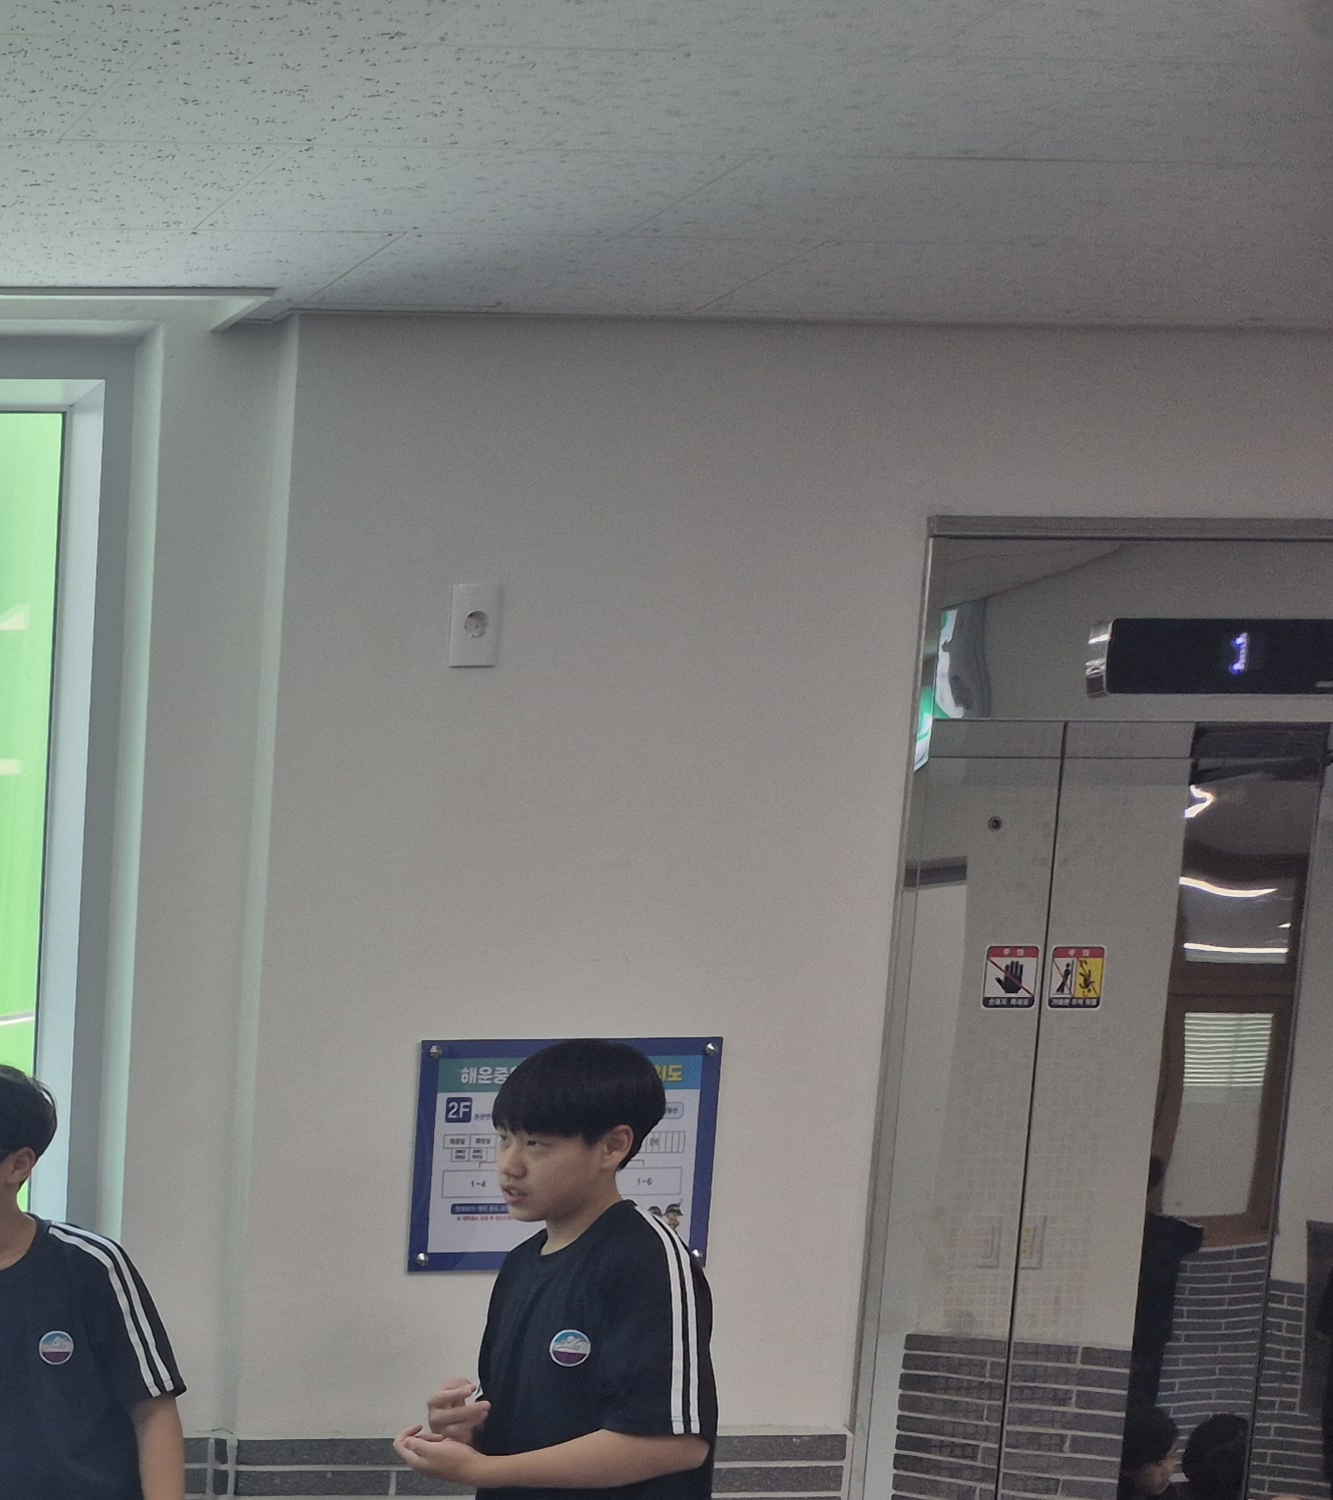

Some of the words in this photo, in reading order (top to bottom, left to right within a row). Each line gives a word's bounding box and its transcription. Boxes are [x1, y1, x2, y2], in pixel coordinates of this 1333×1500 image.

[461, 1066, 514, 1084] 해운중
[447, 1101, 471, 1119] 2F
[637, 1177, 653, 1186] 1-6
